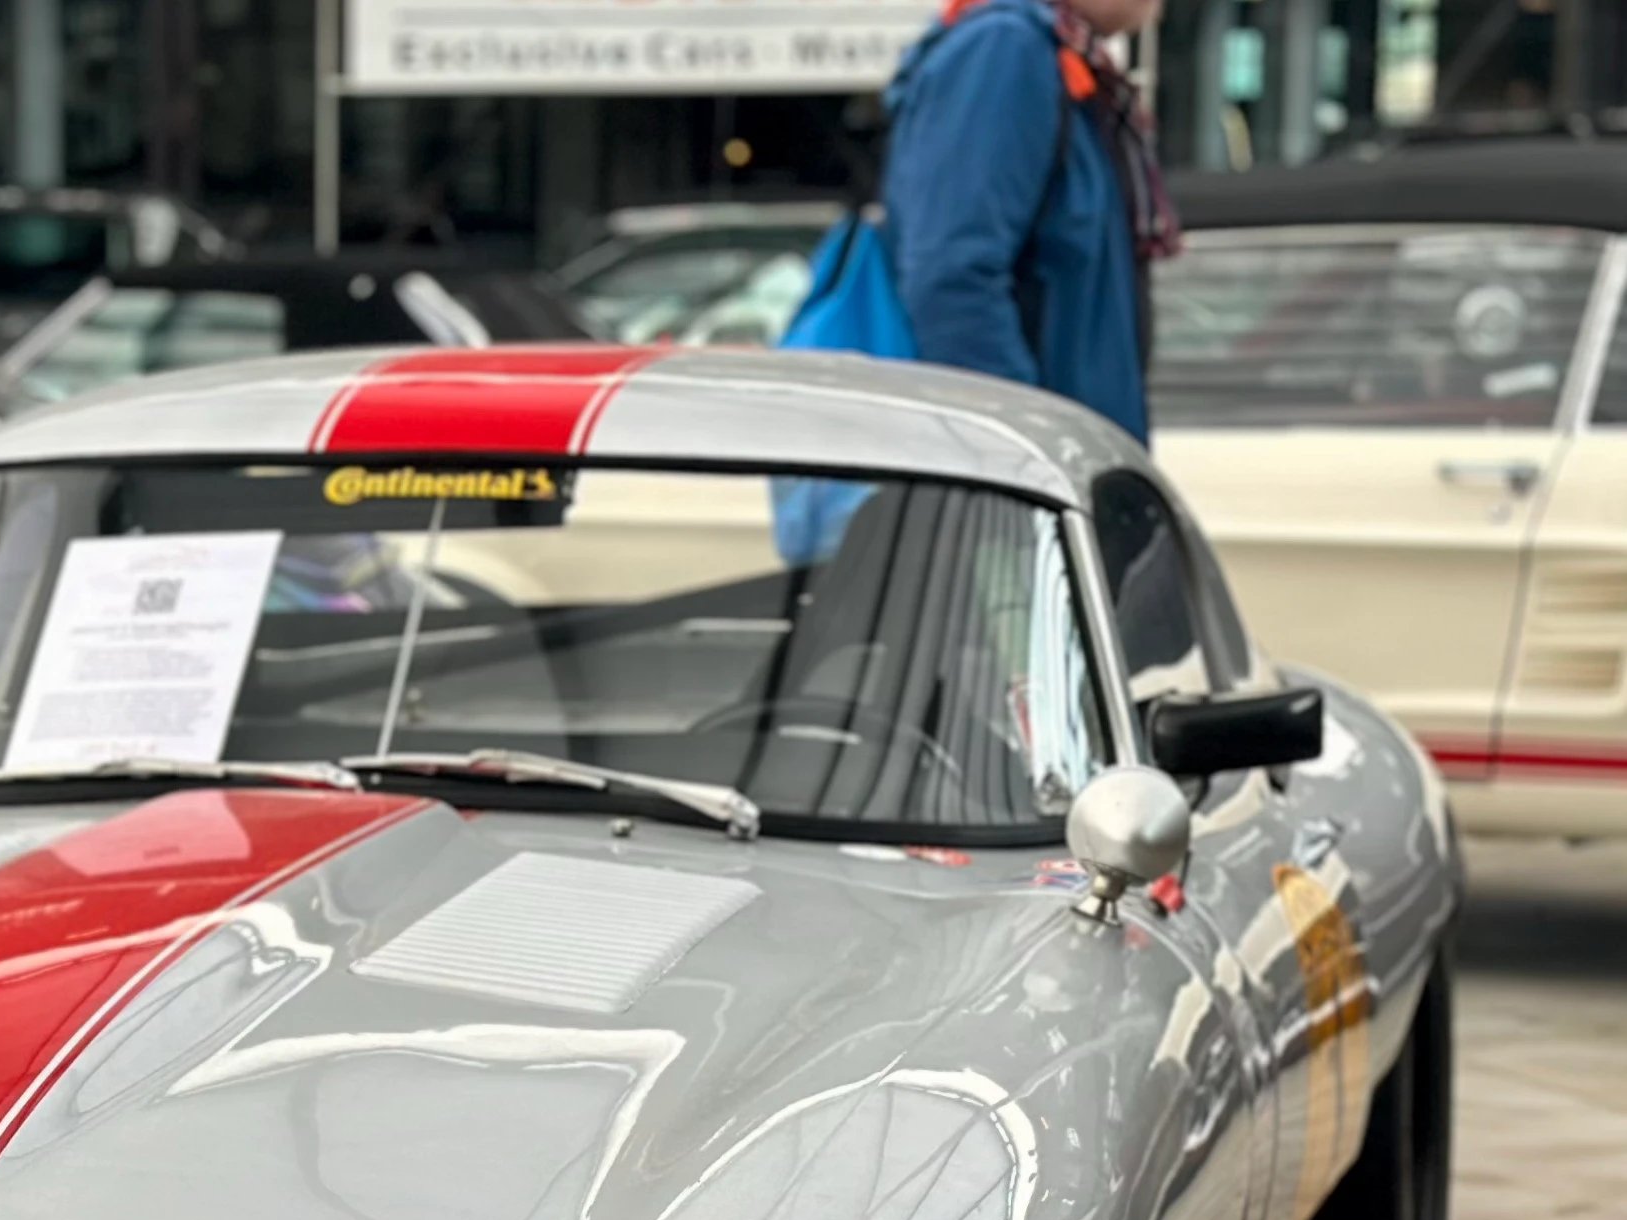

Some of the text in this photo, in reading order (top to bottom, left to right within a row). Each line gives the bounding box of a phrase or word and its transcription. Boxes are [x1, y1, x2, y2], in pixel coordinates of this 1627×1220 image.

[391, 32, 632, 73] Exclusive
[644, 30, 754, 72] Cars
[324, 466, 524, 506] Continental
